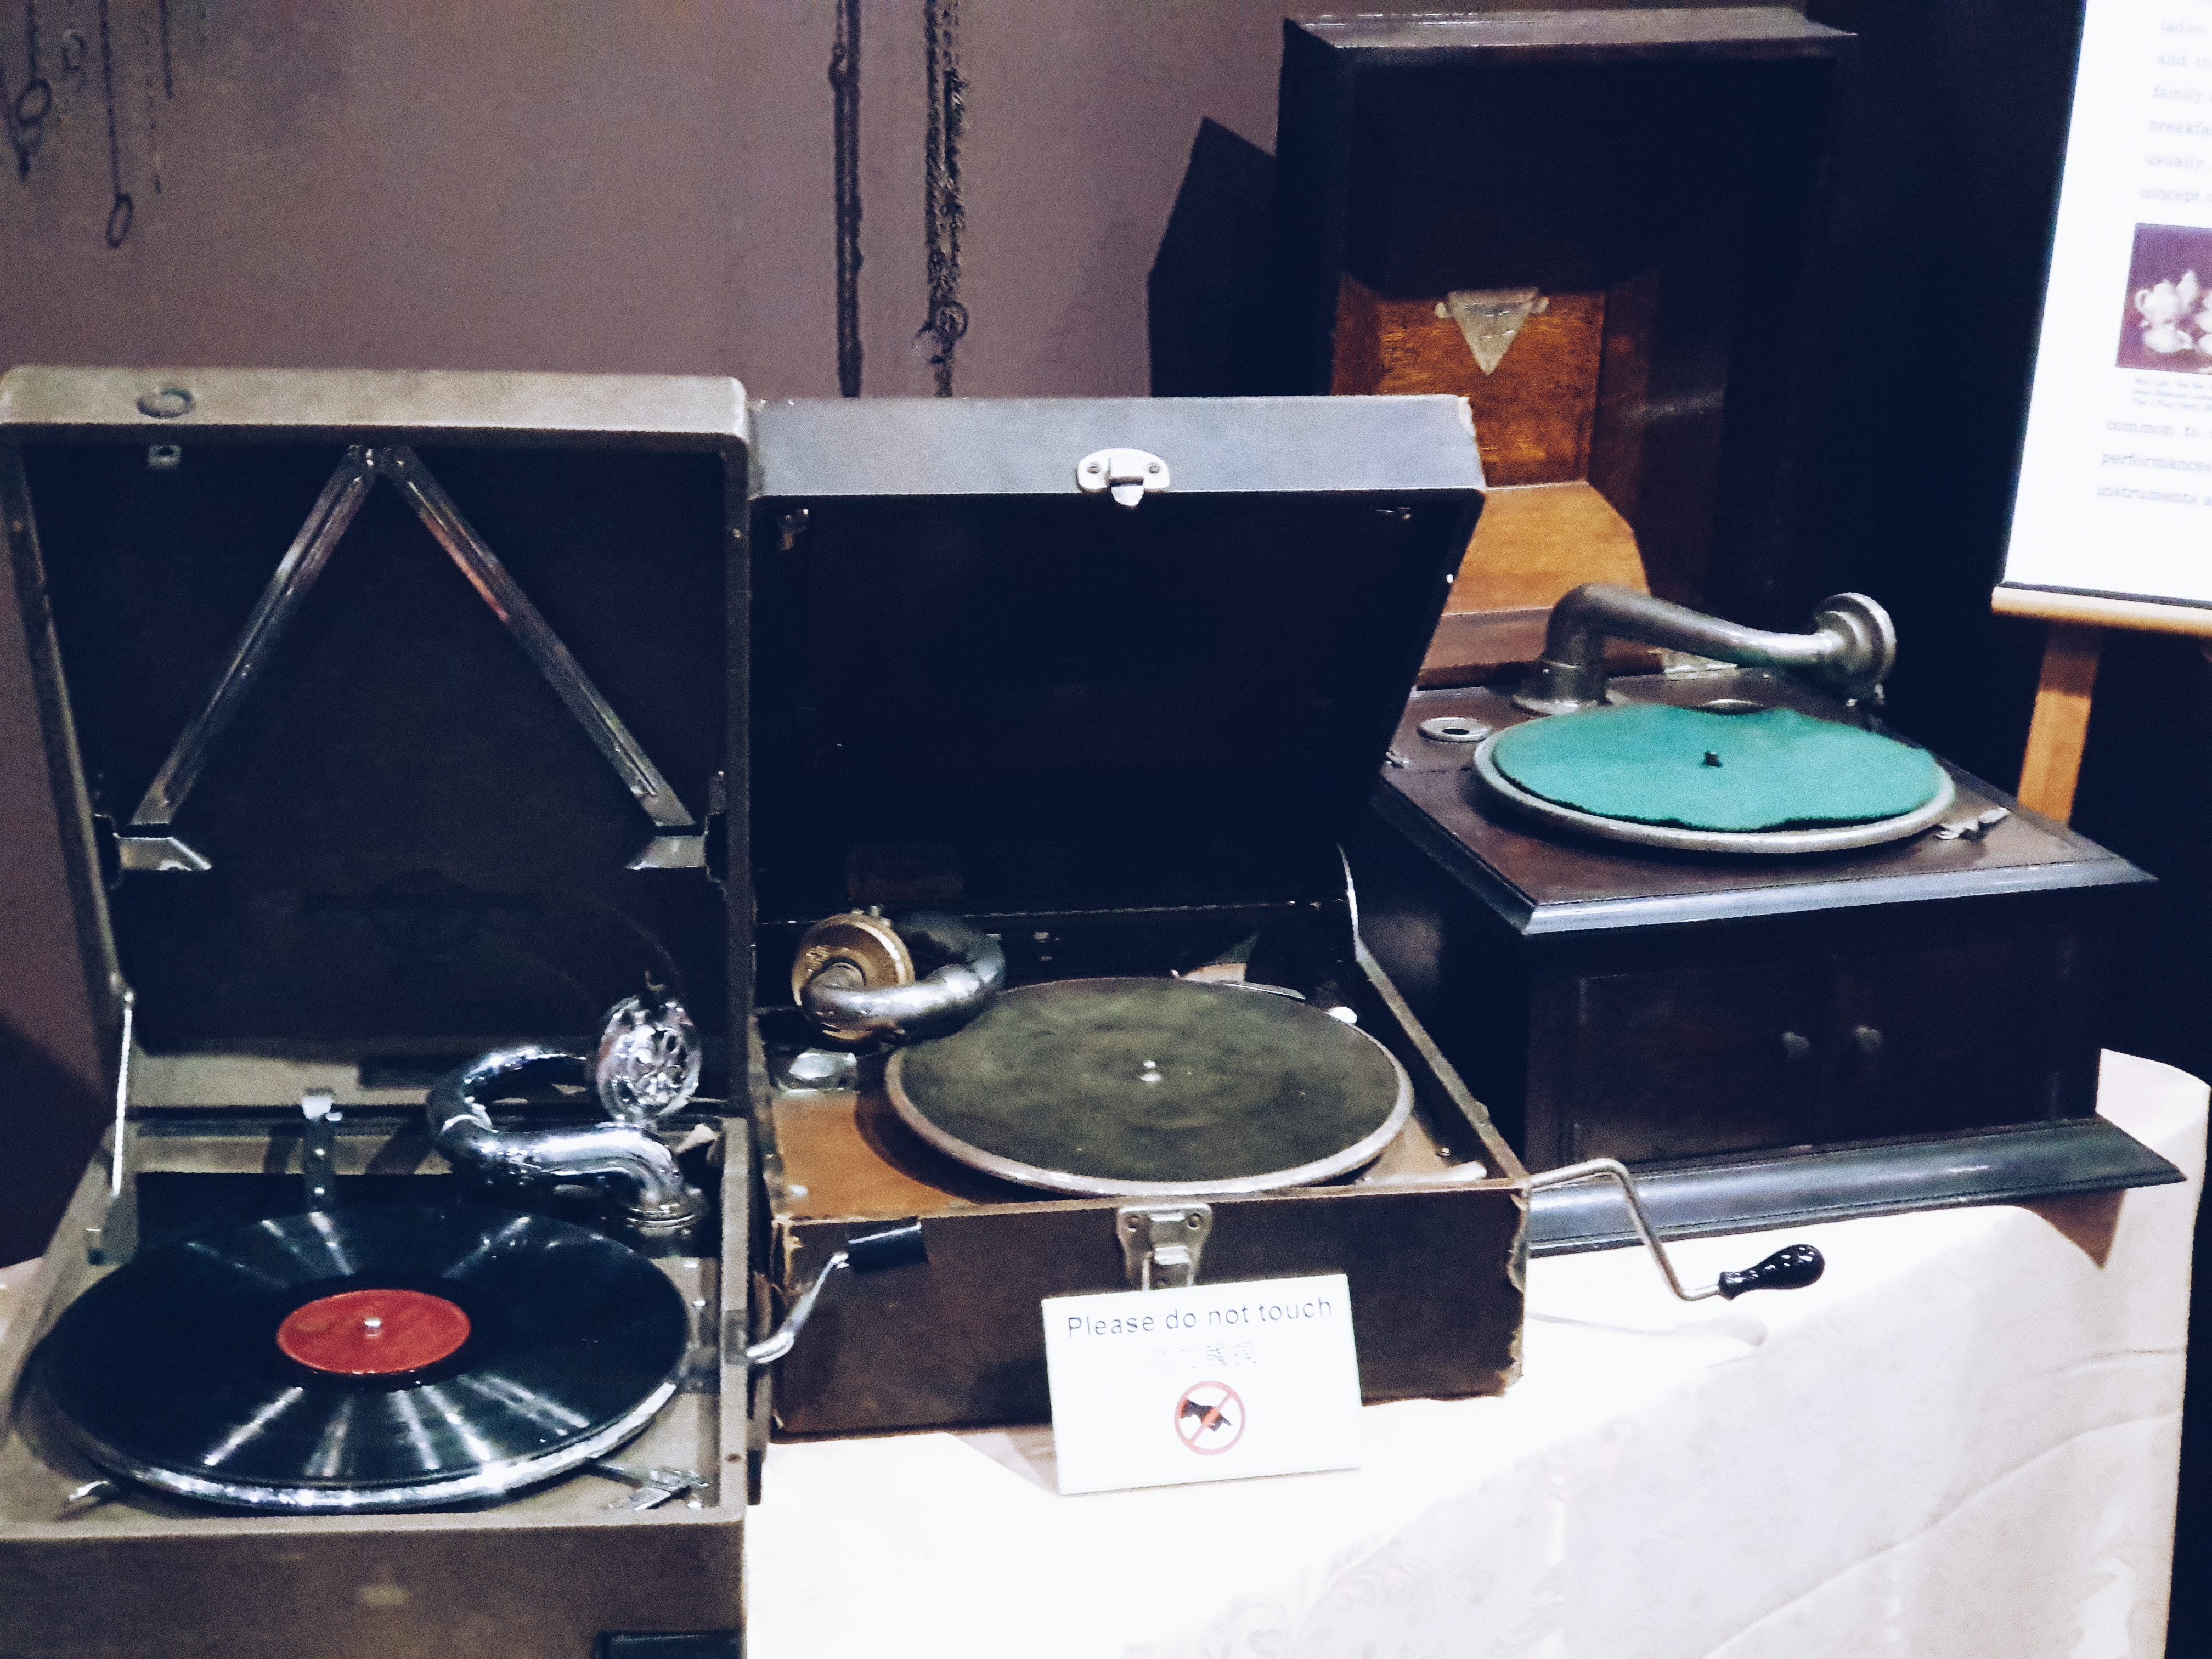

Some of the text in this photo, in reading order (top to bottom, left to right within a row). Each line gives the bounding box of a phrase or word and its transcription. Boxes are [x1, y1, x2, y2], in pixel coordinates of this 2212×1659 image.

[2157, 53, 2186, 66] and
[2154, 84, 2202, 103] family
[2146, 154, 2203, 171] usually
[2139, 189, 2200, 204] concept
[2106, 421, 2199, 437] common to
[2097, 487, 2197, 504] instruments
[1068, 1297, 1332, 1338] Please do not touch
